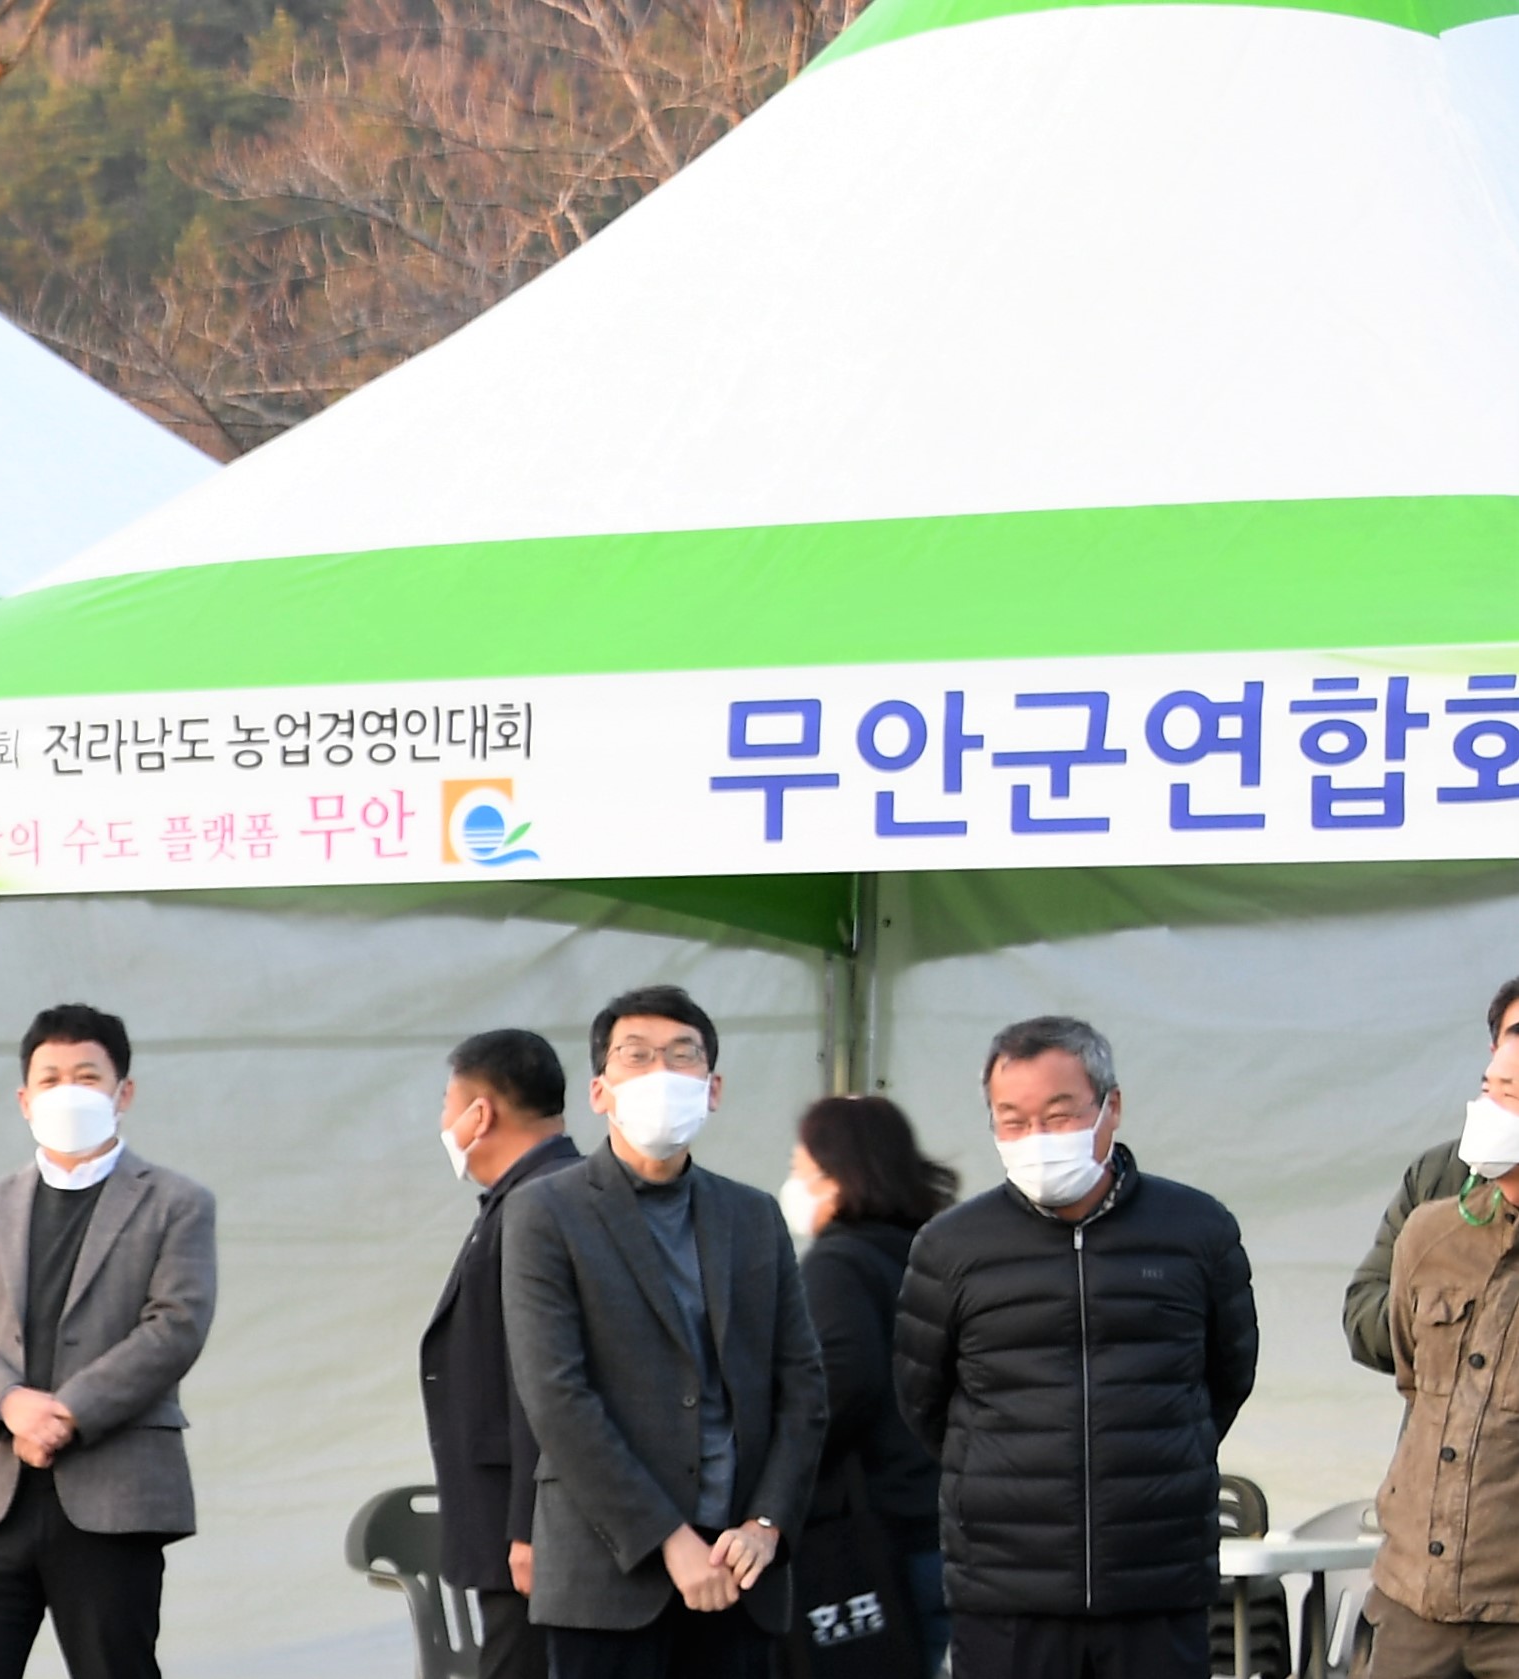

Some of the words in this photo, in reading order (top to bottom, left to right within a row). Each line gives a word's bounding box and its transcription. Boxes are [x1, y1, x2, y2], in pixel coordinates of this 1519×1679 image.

[42, 717, 216, 776] 전라남도
[227, 702, 534, 771] 농업경영인대회
[63, 818, 141, 866] 수도
[159, 811, 281, 864] 플랫폼
[299, 788, 418, 864] 무안
